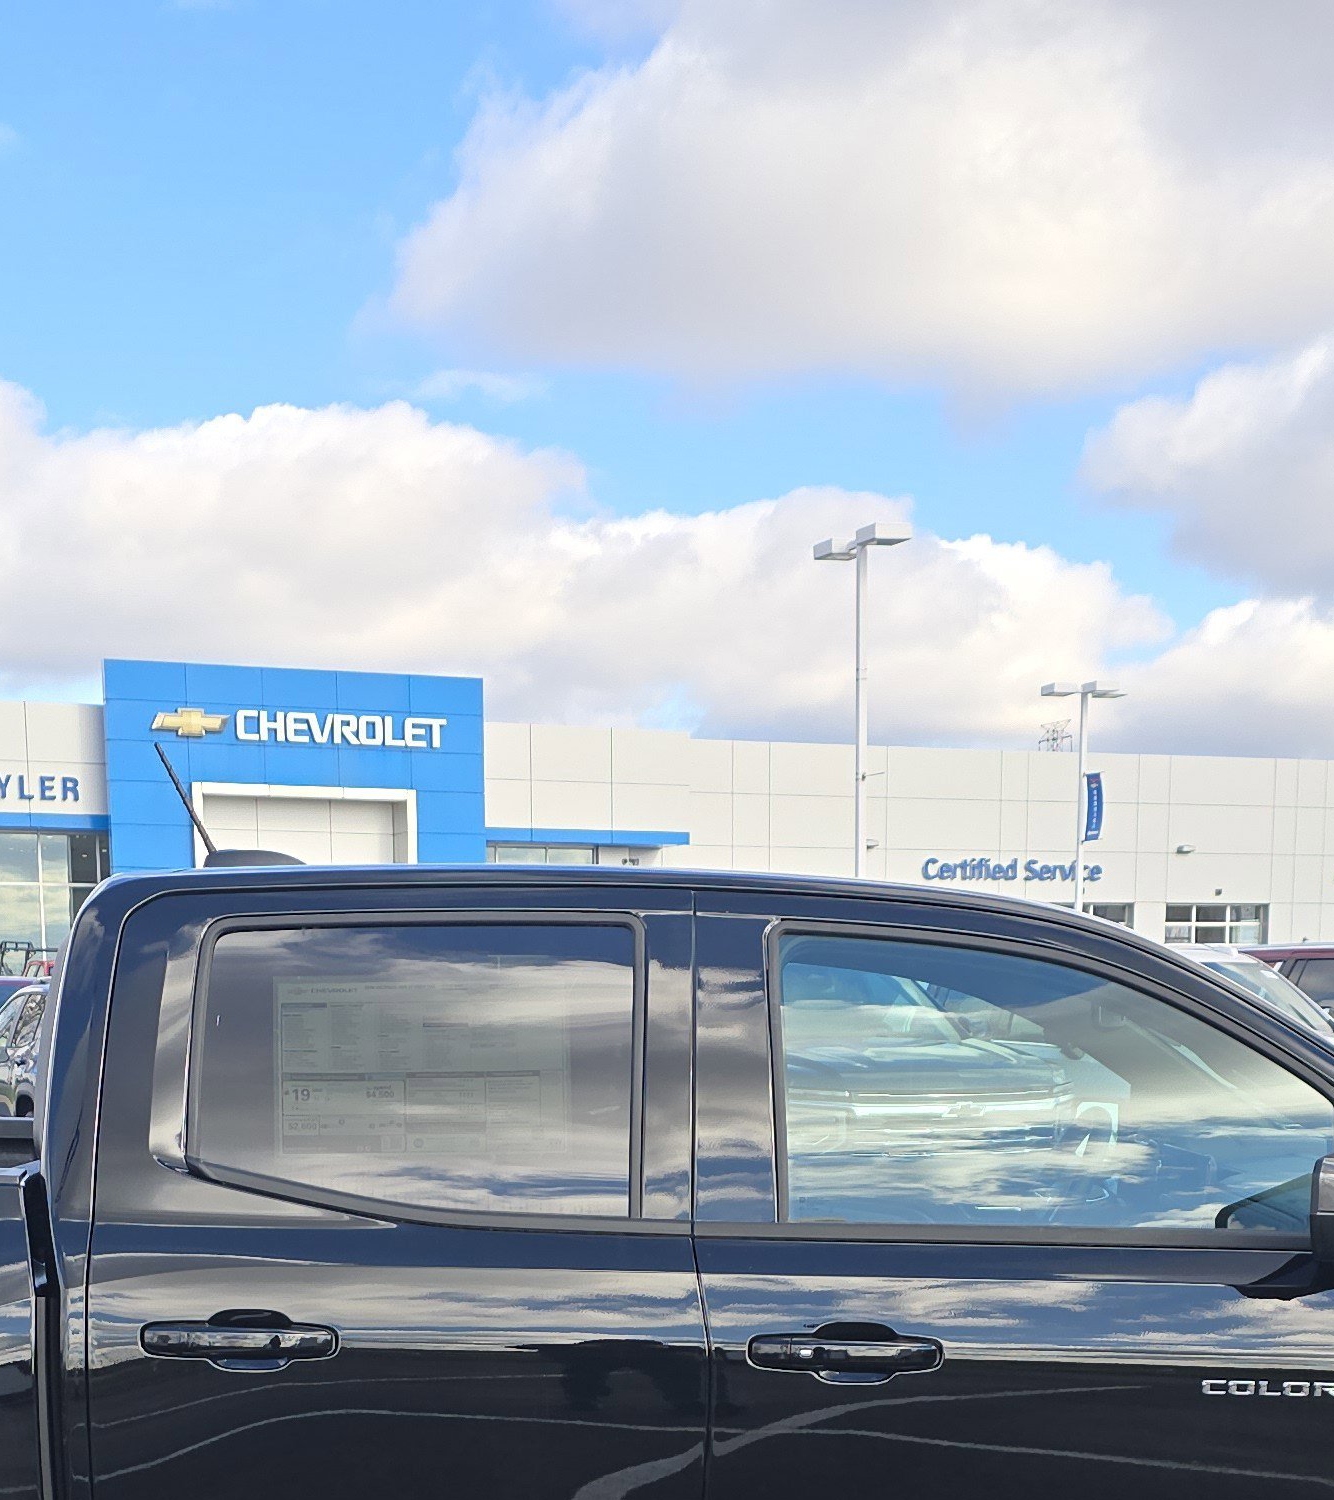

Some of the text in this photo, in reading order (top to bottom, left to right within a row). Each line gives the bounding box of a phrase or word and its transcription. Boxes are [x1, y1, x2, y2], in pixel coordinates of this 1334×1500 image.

[235, 709, 447, 748] CHEVROLET
[922, 857, 1017, 881] Certified
[291, 1088, 311, 1101] 19
